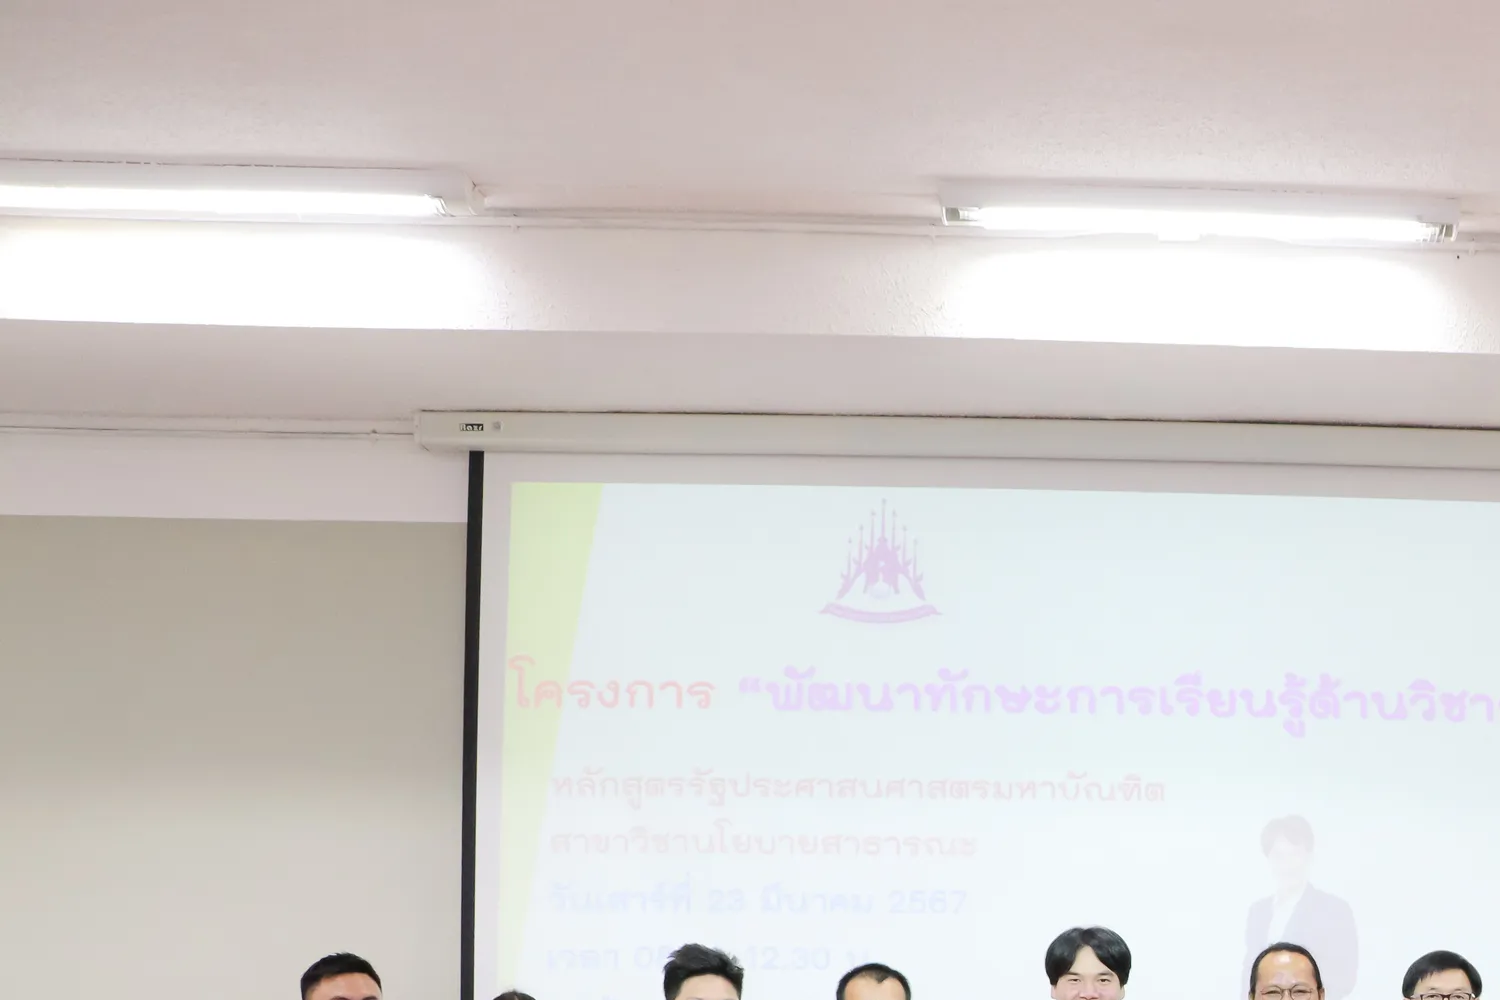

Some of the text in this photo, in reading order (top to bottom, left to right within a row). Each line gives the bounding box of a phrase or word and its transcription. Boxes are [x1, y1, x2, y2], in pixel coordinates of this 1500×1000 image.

[506, 655, 716, 711] โครงการ
[550, 817, 979, 857] สาขาวิชานโยบายสาธารณะ
[707, 887, 745, 914] 23
[759, 881, 875, 915] มีนาคม
[886, 888, 968, 916] 2567
